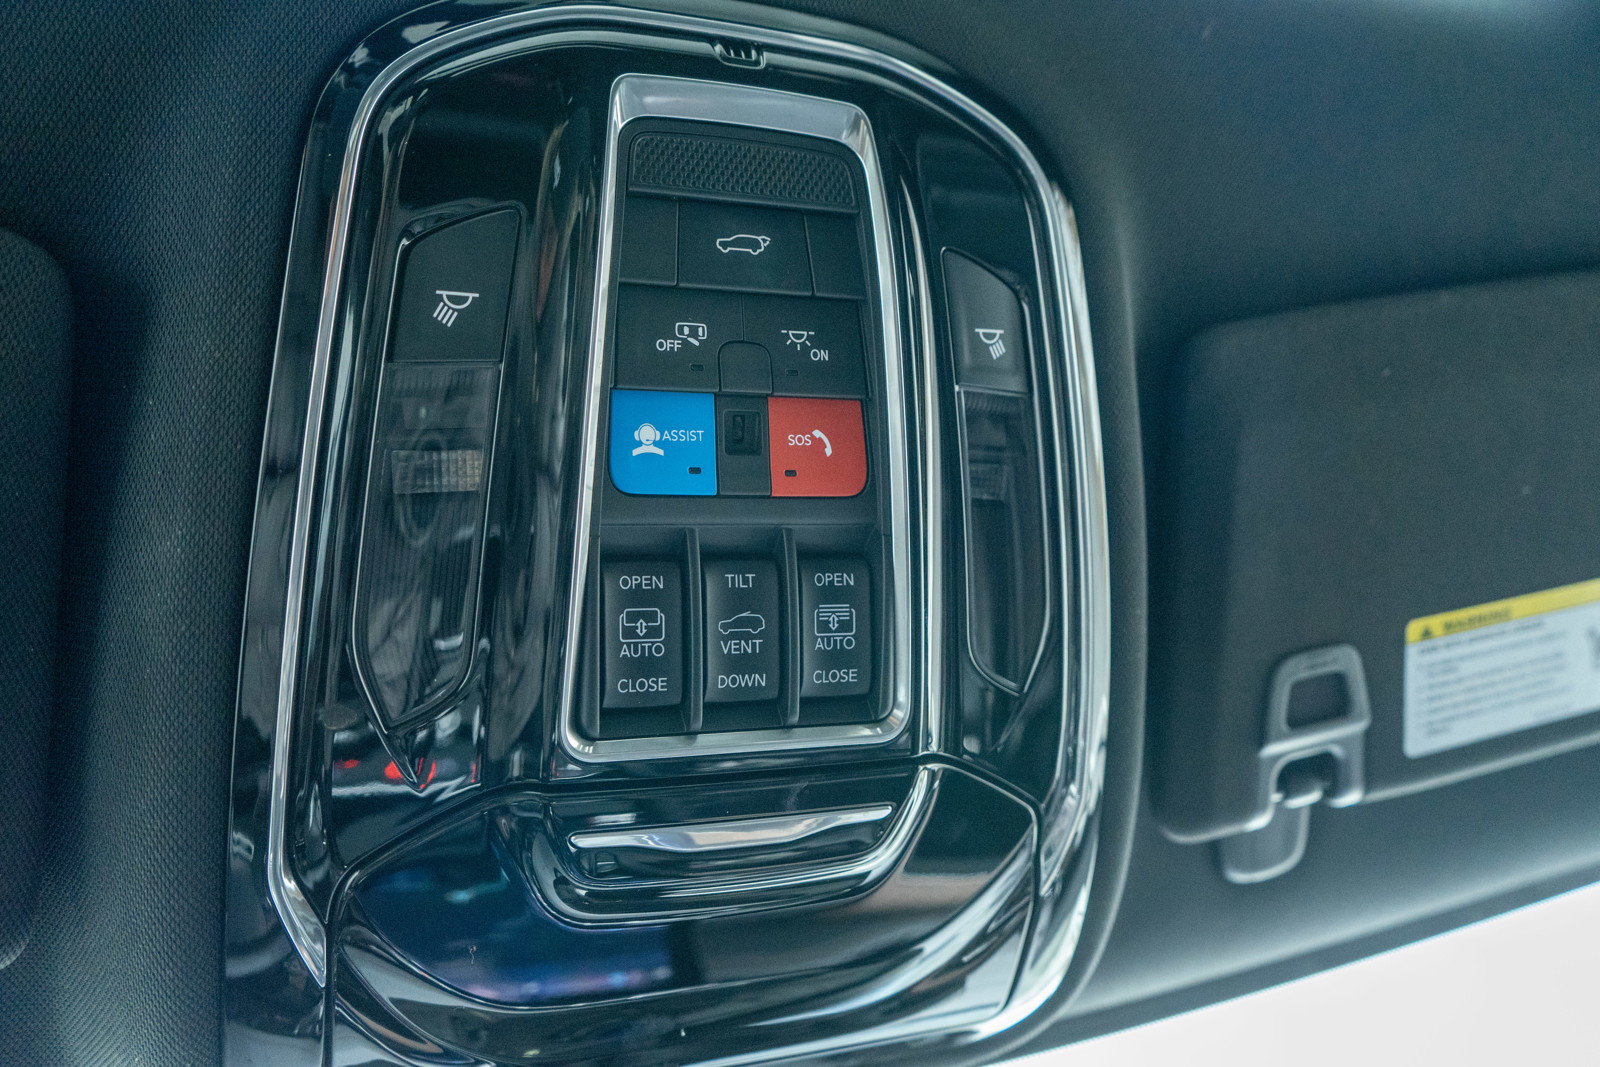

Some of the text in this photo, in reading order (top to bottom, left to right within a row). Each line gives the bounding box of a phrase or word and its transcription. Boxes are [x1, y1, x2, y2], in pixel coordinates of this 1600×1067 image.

[656, 339, 682, 352] OFF
[810, 349, 829, 361] ON
[662, 430, 704, 442] ASSIST
[788, 434, 812, 446] SOS
[619, 575, 664, 590] OPEN
[725, 573, 756, 588] TILT
[814, 573, 854, 586] OPEN
[619, 642, 665, 658] AUTO
[720, 639, 763, 654] VENT
[815, 636, 856, 651] AUTO
[718, 673, 766, 689] DOWN
[813, 668, 858, 684] CLOSE
[617, 677, 668, 693] CLOSE
